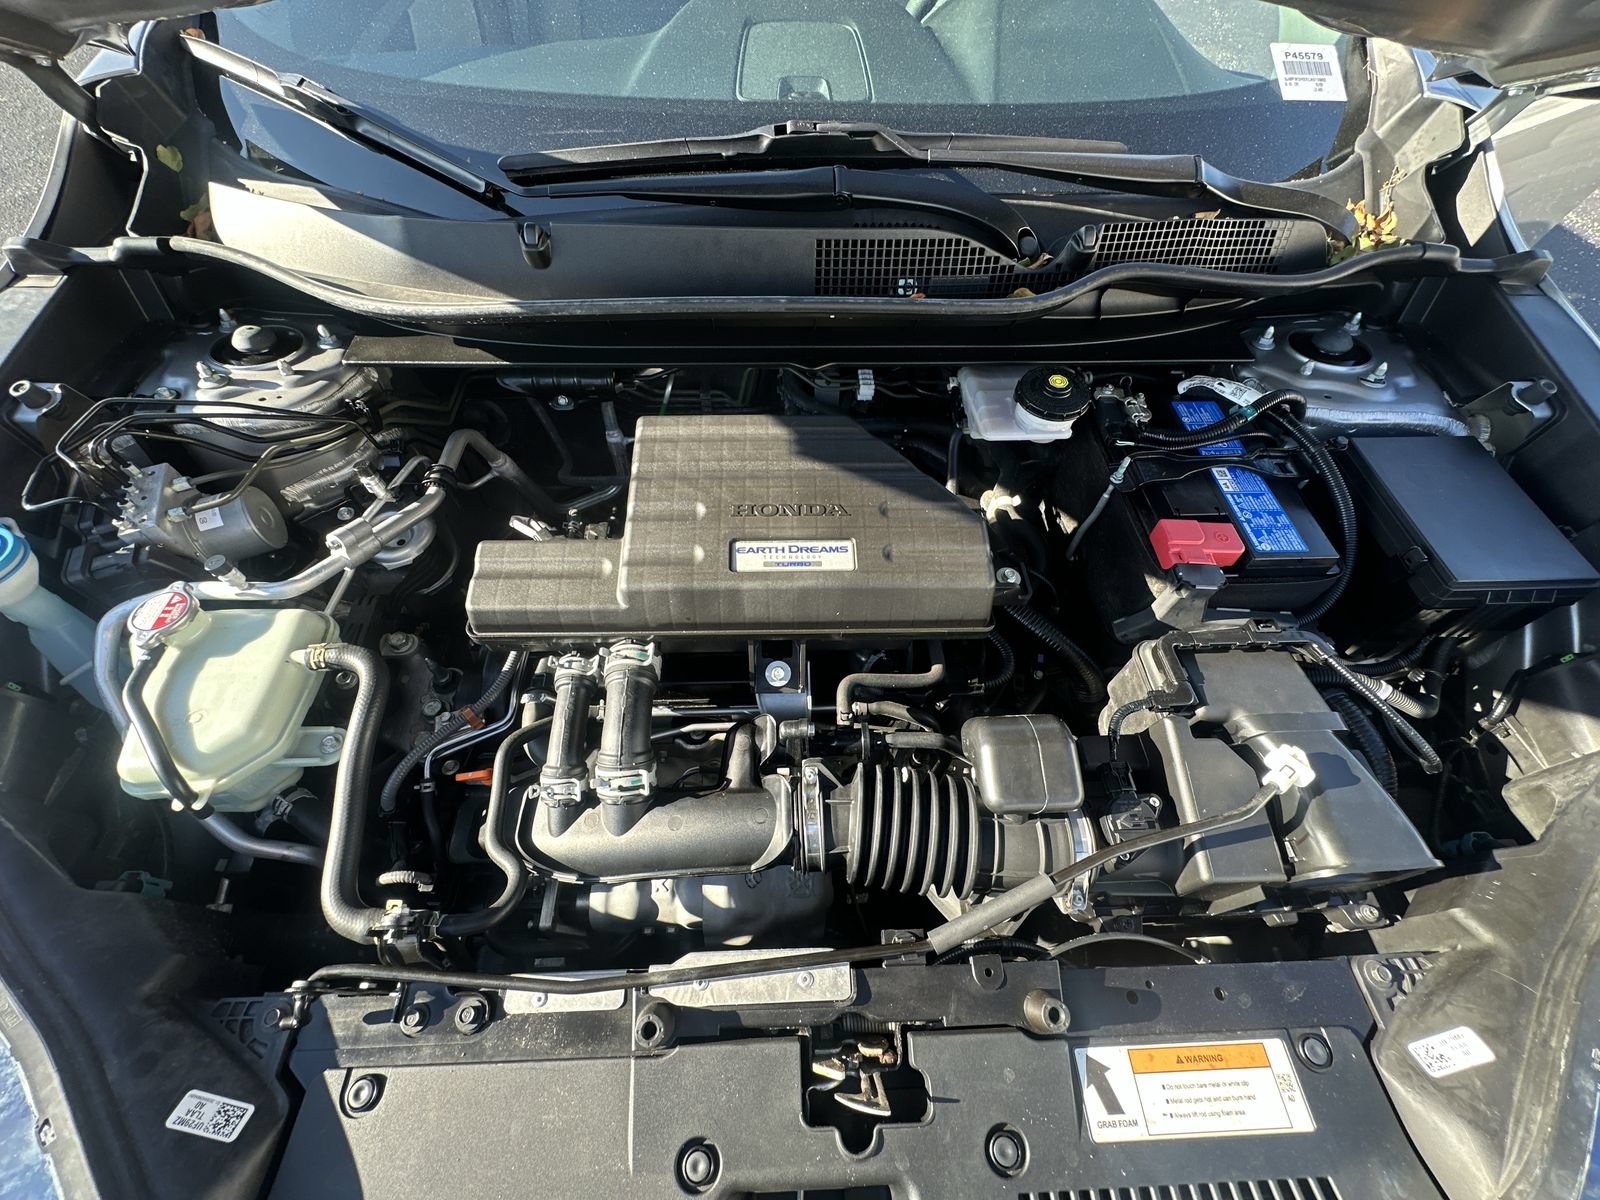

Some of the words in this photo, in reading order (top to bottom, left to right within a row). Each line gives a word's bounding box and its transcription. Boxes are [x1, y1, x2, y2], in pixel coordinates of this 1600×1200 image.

[730, 503, 852, 517] HONDA
[735, 545, 785, 554] EARTH
[788, 545, 849, 553] DREAMS
[1184, 1054, 1224, 1064] WARNING
[185, 1108, 205, 1120] TLAA
[1096, 1120, 1118, 1129] GRAB
[1118, 1119, 1139, 1128] FOAM
